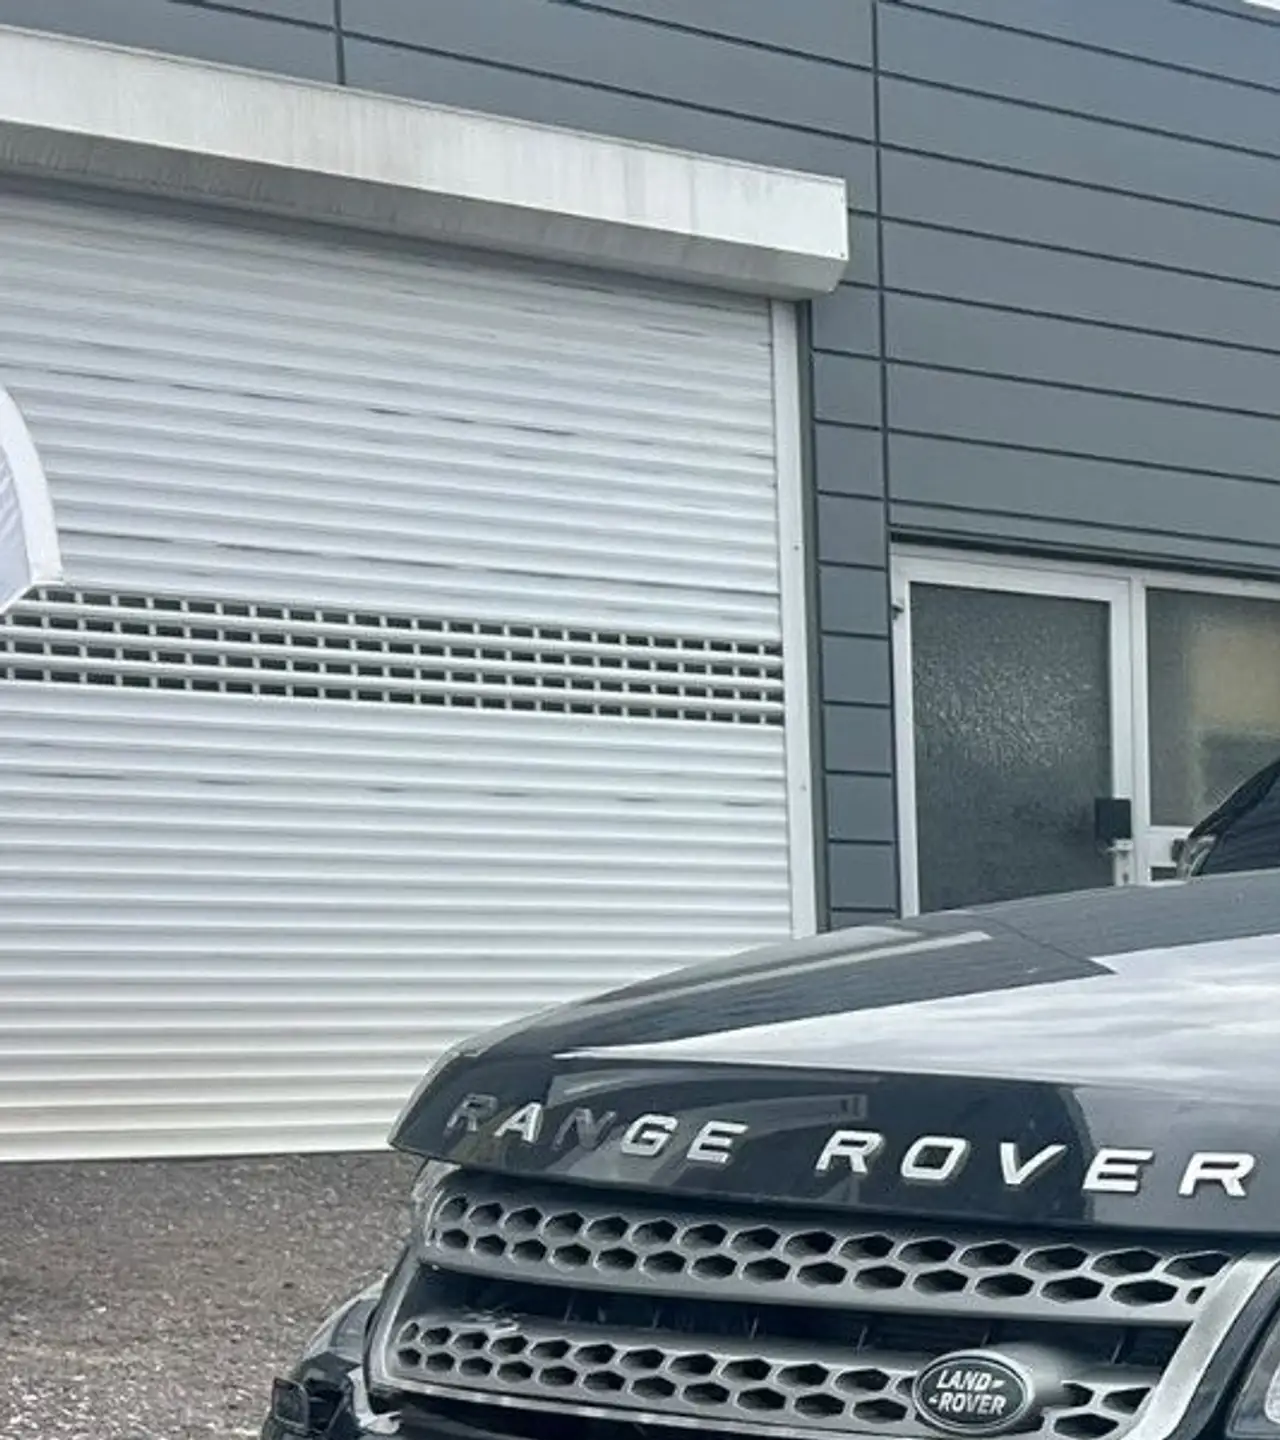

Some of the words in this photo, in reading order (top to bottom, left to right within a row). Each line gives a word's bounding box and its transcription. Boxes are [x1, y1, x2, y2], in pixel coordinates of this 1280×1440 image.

[443, 1092, 749, 1165] RANGE
[814, 1129, 1257, 1198] ROVER
[936, 1369, 993, 1392] LAND
[937, 1391, 1007, 1416] ROVER
